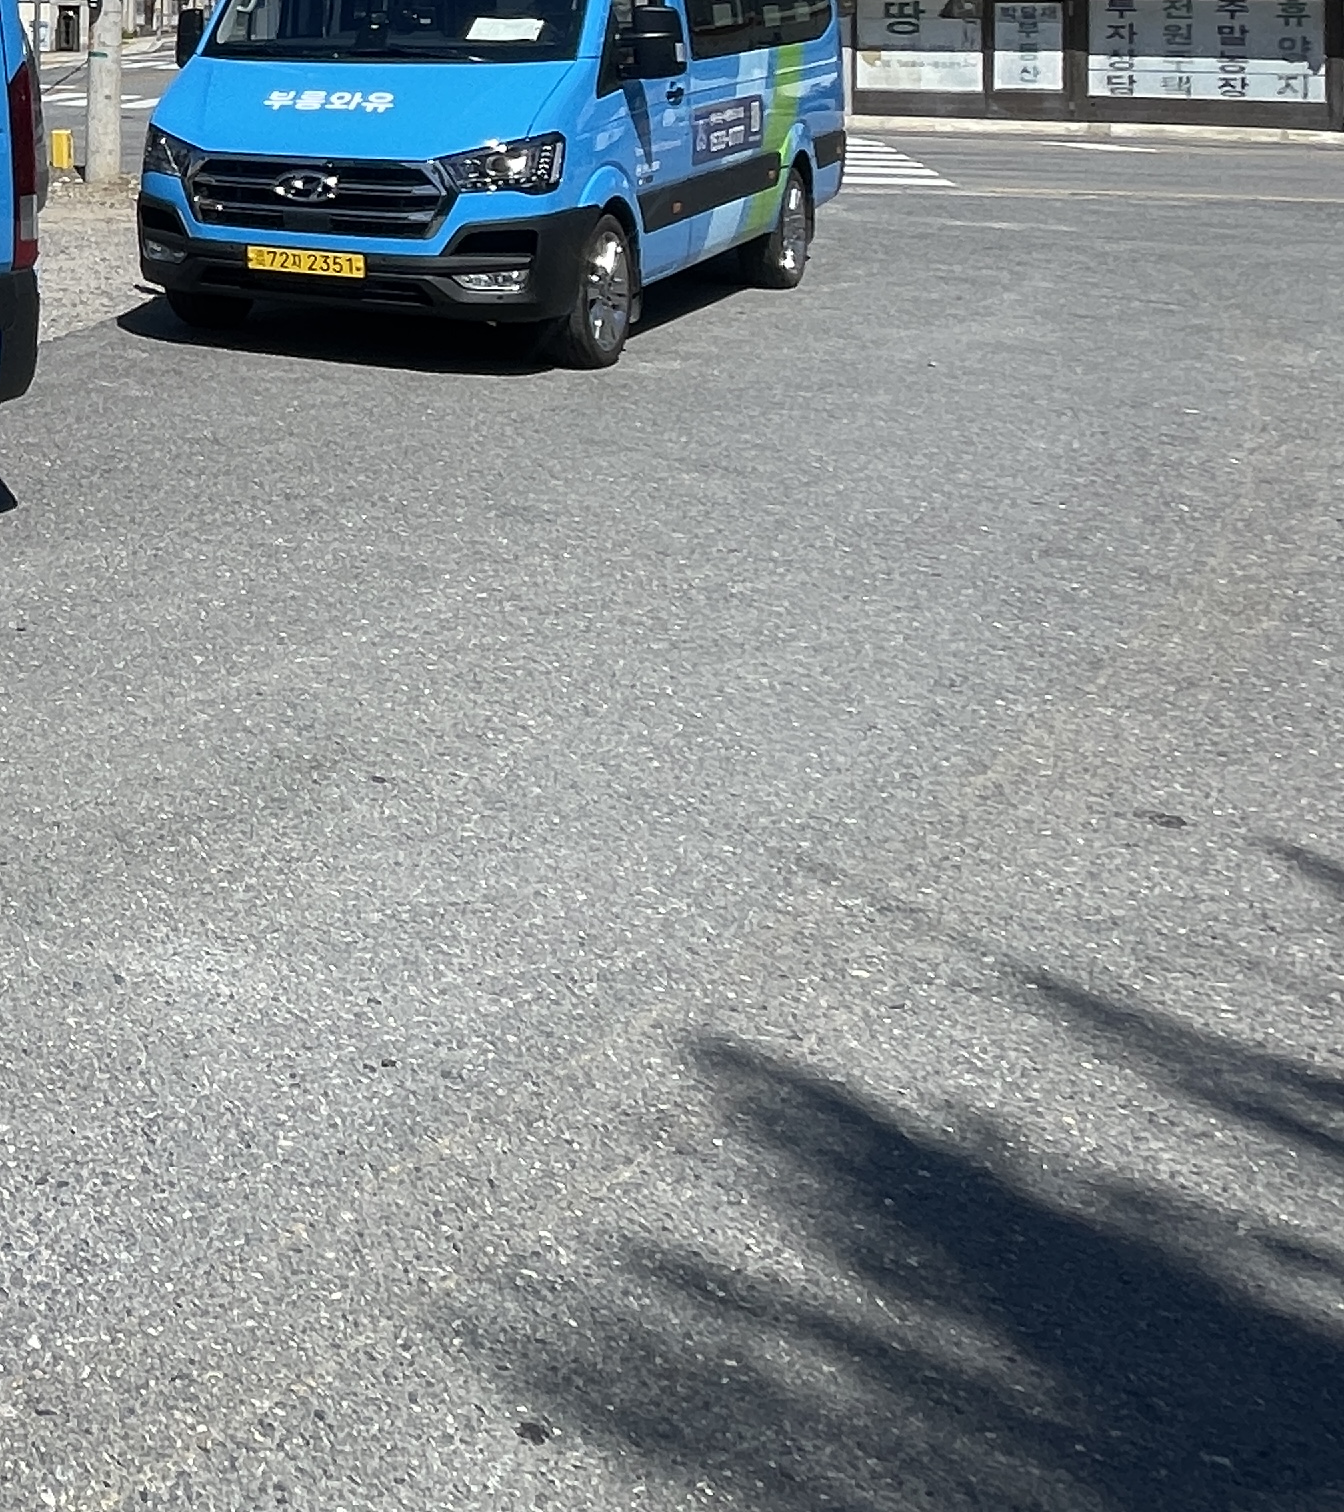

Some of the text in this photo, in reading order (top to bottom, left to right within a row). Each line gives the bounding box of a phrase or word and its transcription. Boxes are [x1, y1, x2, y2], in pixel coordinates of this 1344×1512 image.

[884, 0, 926, 34] 땅
[1017, 21, 1041, 83] 부동산
[307, 254, 354, 274] 2351
